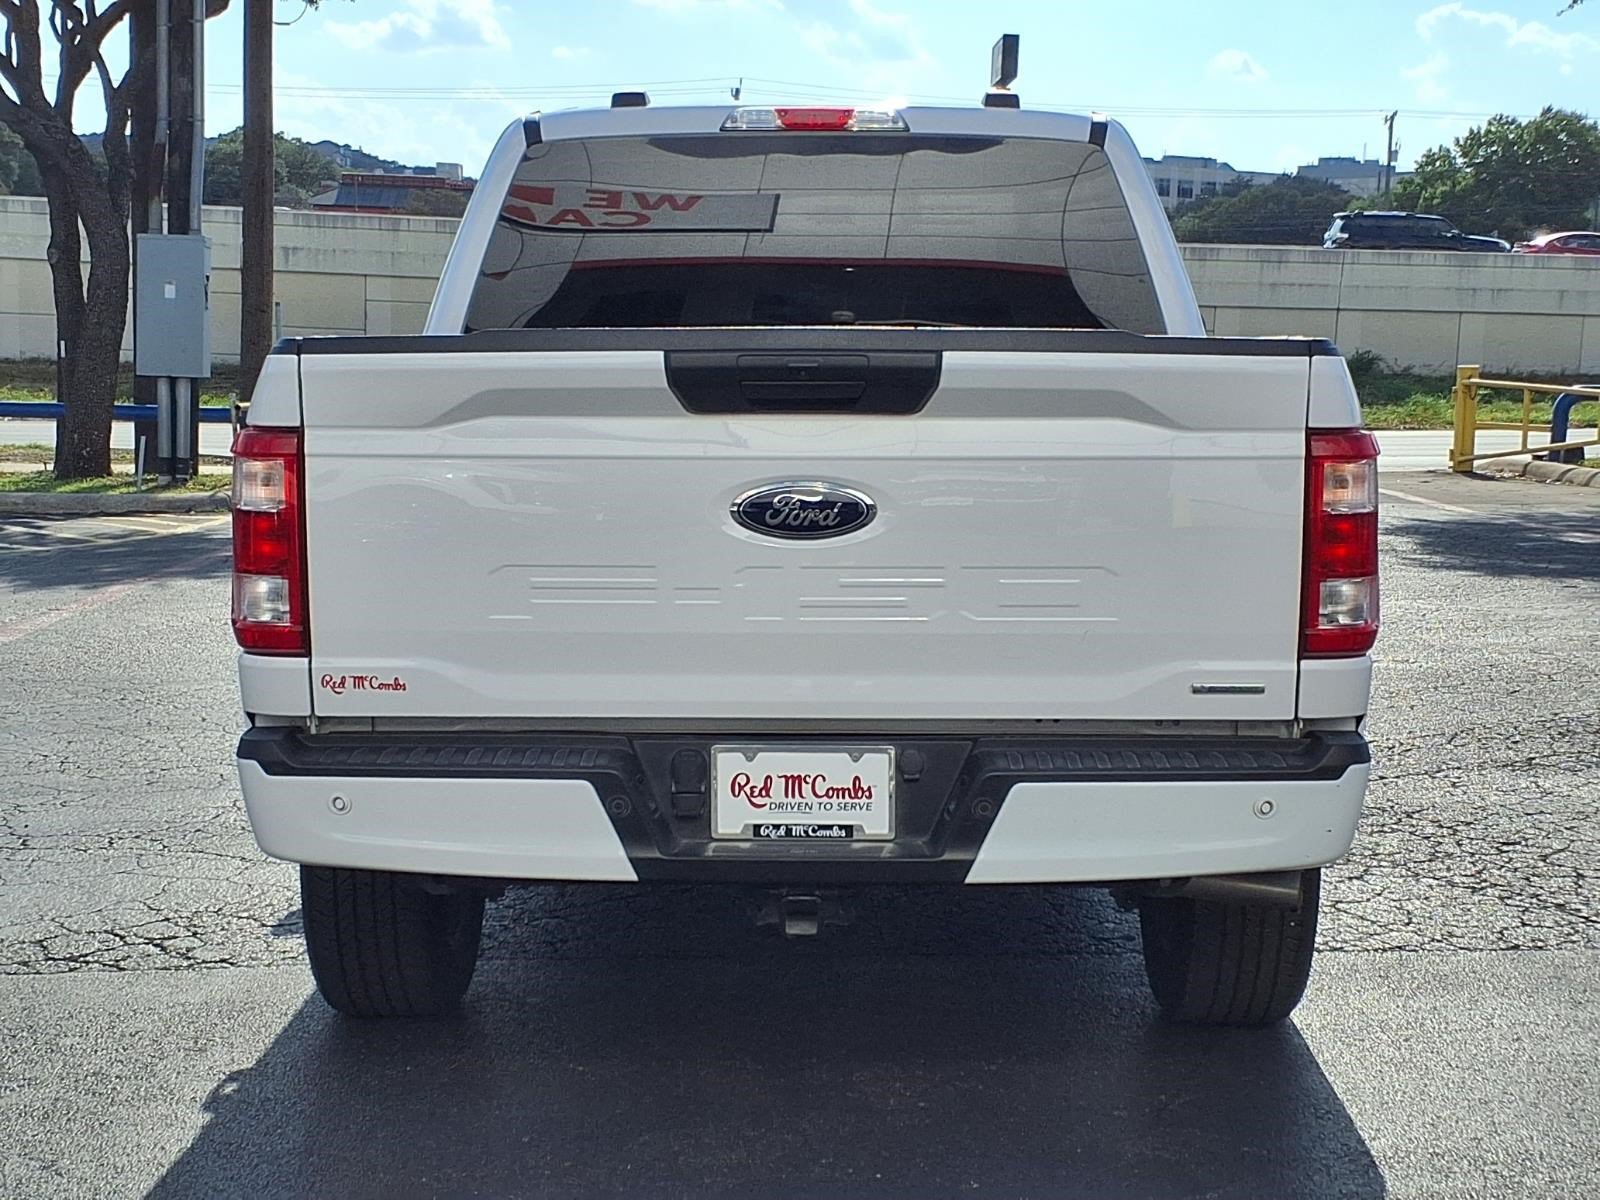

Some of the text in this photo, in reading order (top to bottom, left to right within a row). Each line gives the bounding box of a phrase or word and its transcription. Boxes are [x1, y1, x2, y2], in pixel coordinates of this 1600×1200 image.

[765, 493, 843, 527] Ford
[321, 673, 407, 695] Red McCombs
[730, 772, 873, 809] Red McCombs
[768, 801, 873, 812] DRIVEN TO SERVE
[760, 824, 846, 839] Red McCombs
